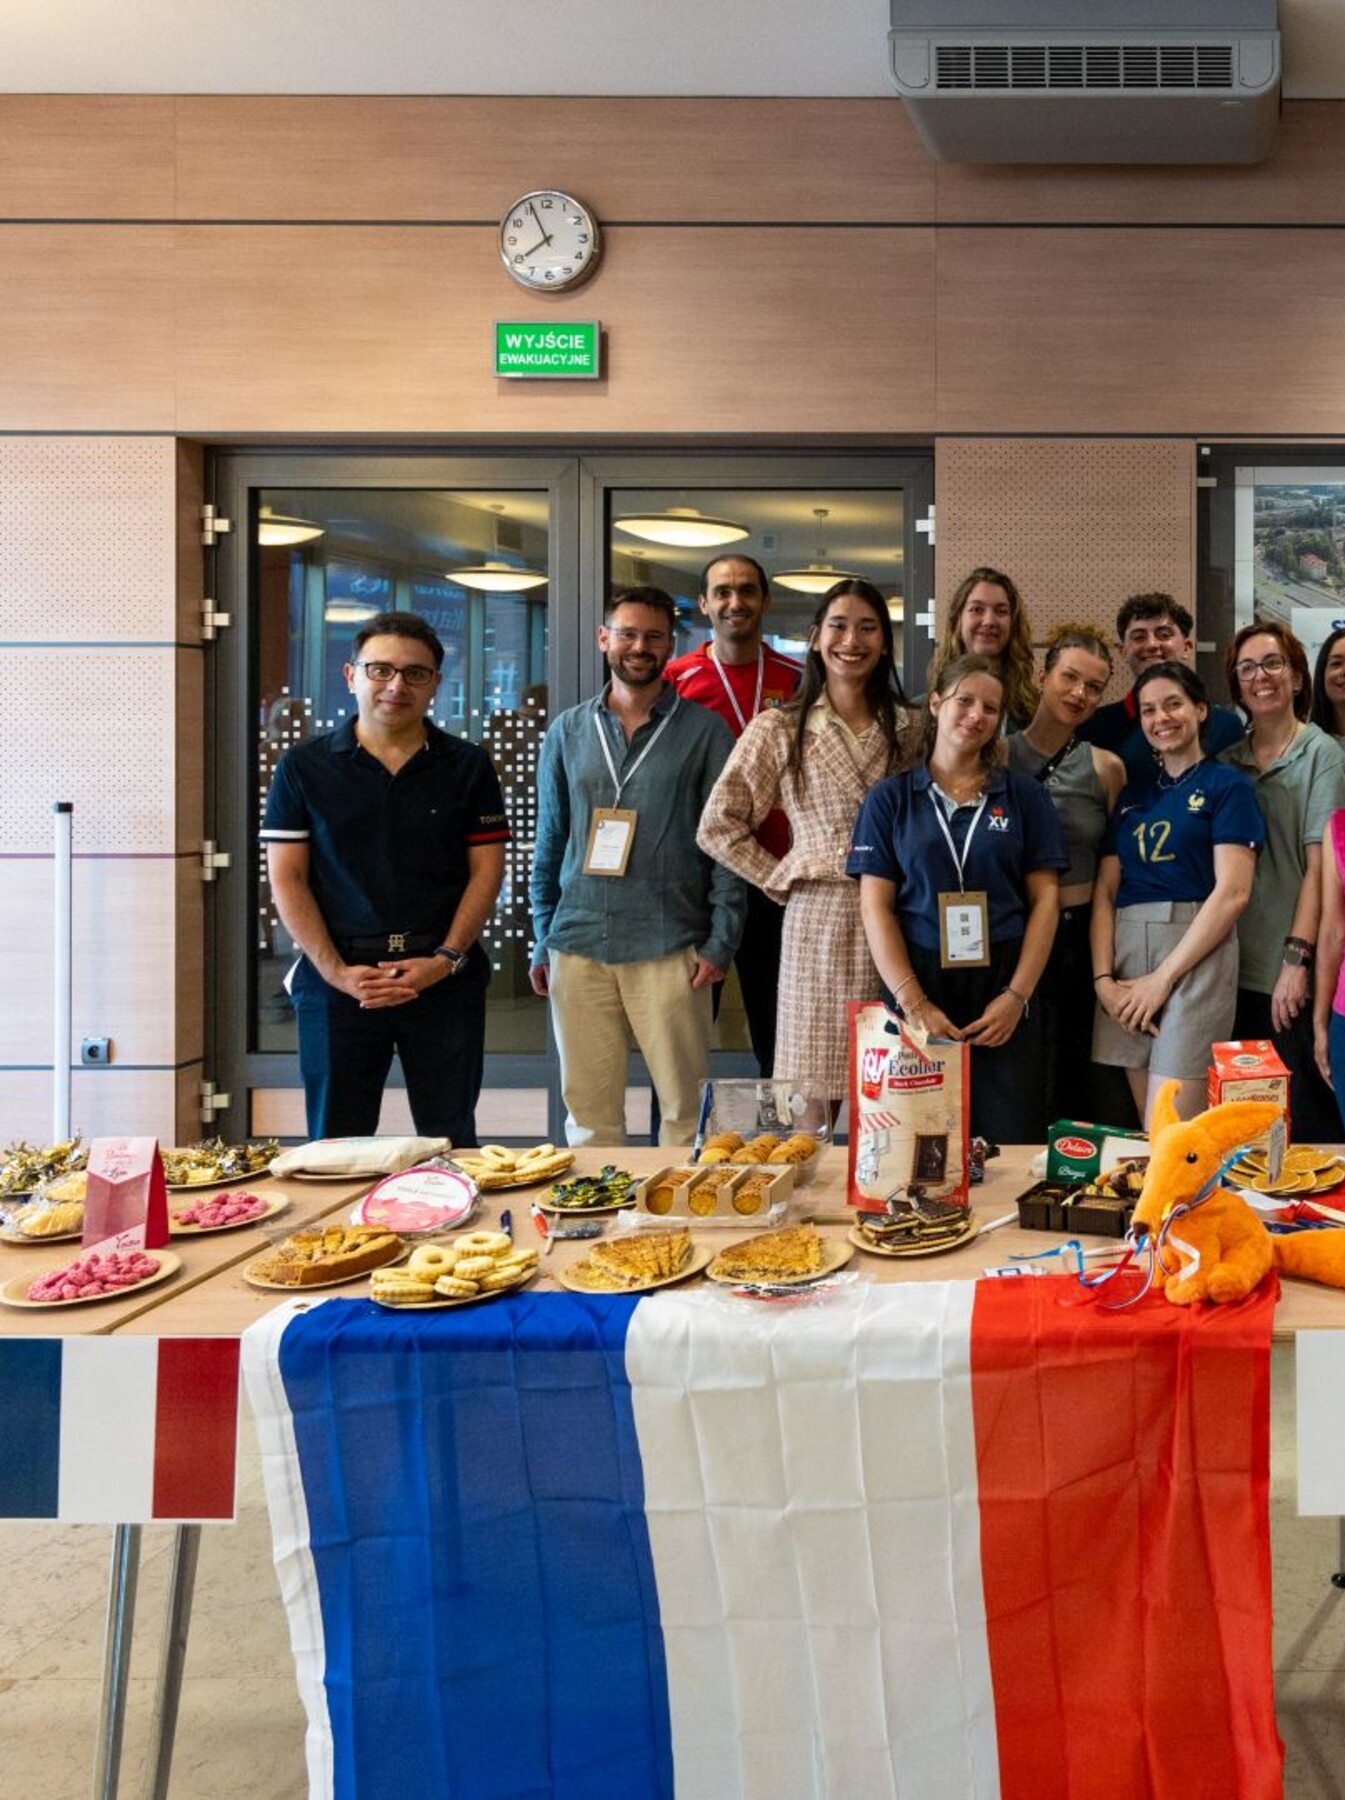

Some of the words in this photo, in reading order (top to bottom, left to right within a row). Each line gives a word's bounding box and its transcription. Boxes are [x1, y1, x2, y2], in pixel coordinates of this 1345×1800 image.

[541, 200, 553, 209] 12
[513, 219, 523, 228] 10
[573, 216, 583, 225] 2
[508, 236, 517, 245] 9
[579, 234, 588, 243] 3
[514, 255, 524, 264] 8
[574, 251, 583, 260] 4
[545, 270, 554, 280] 6
[506, 332, 585, 349] WYJŚCIE
[500, 353, 590, 366] EWAKUACYJNE
[988, 815, 1009, 830] XV
[1133, 822, 1176, 862] 12
